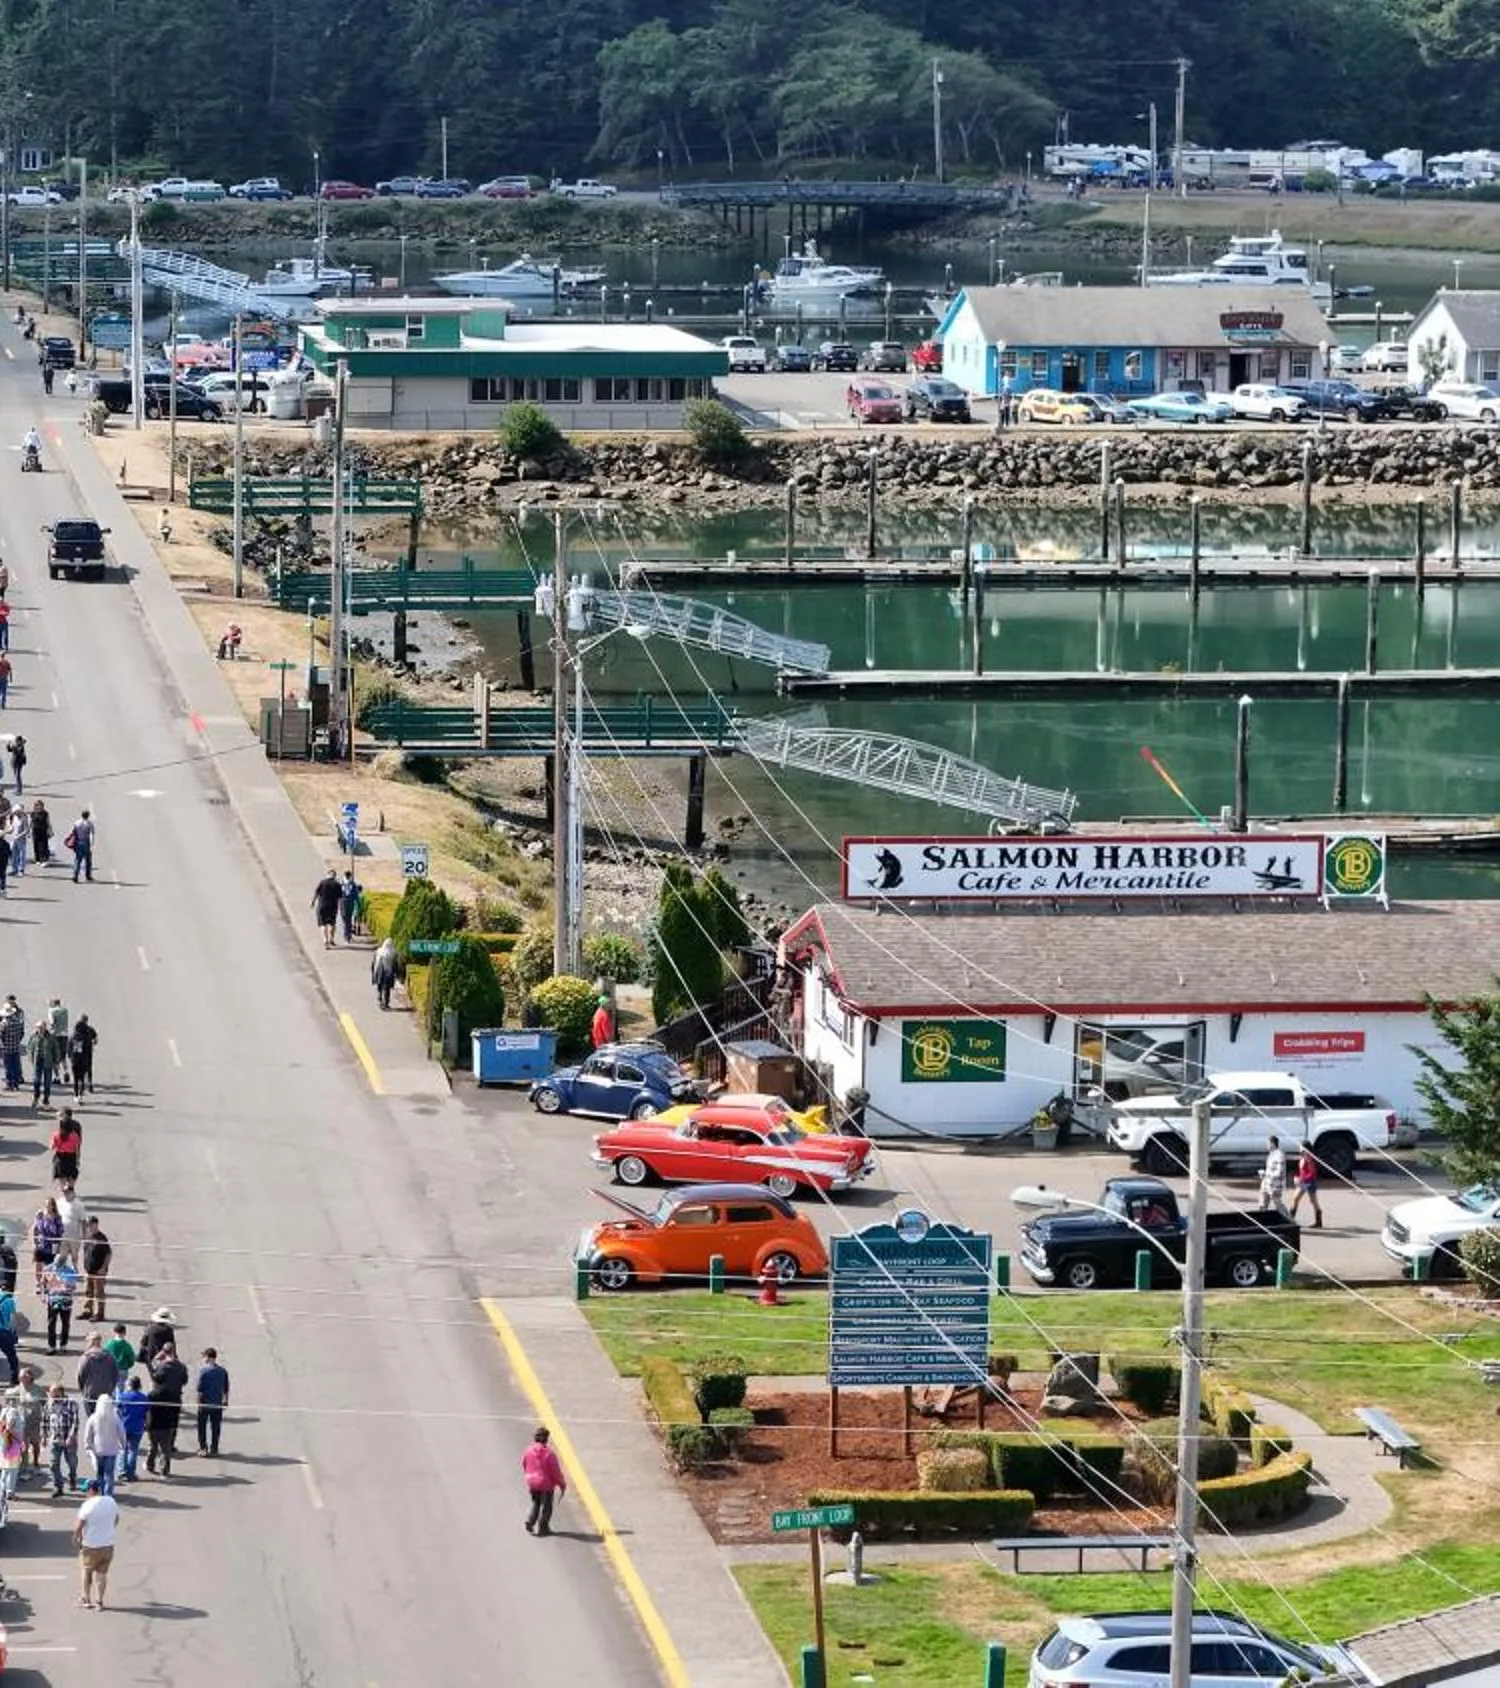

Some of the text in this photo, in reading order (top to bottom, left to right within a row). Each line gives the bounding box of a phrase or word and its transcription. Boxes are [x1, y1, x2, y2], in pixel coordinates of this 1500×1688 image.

[404, 861, 425, 873] 20
[921, 845, 1248, 871] SALMON HARBOR
[957, 871, 1212, 892] Cafe & Mercantile
[775, 1515, 791, 1528] BAY
[829, 1507, 852, 1523] LOOP
